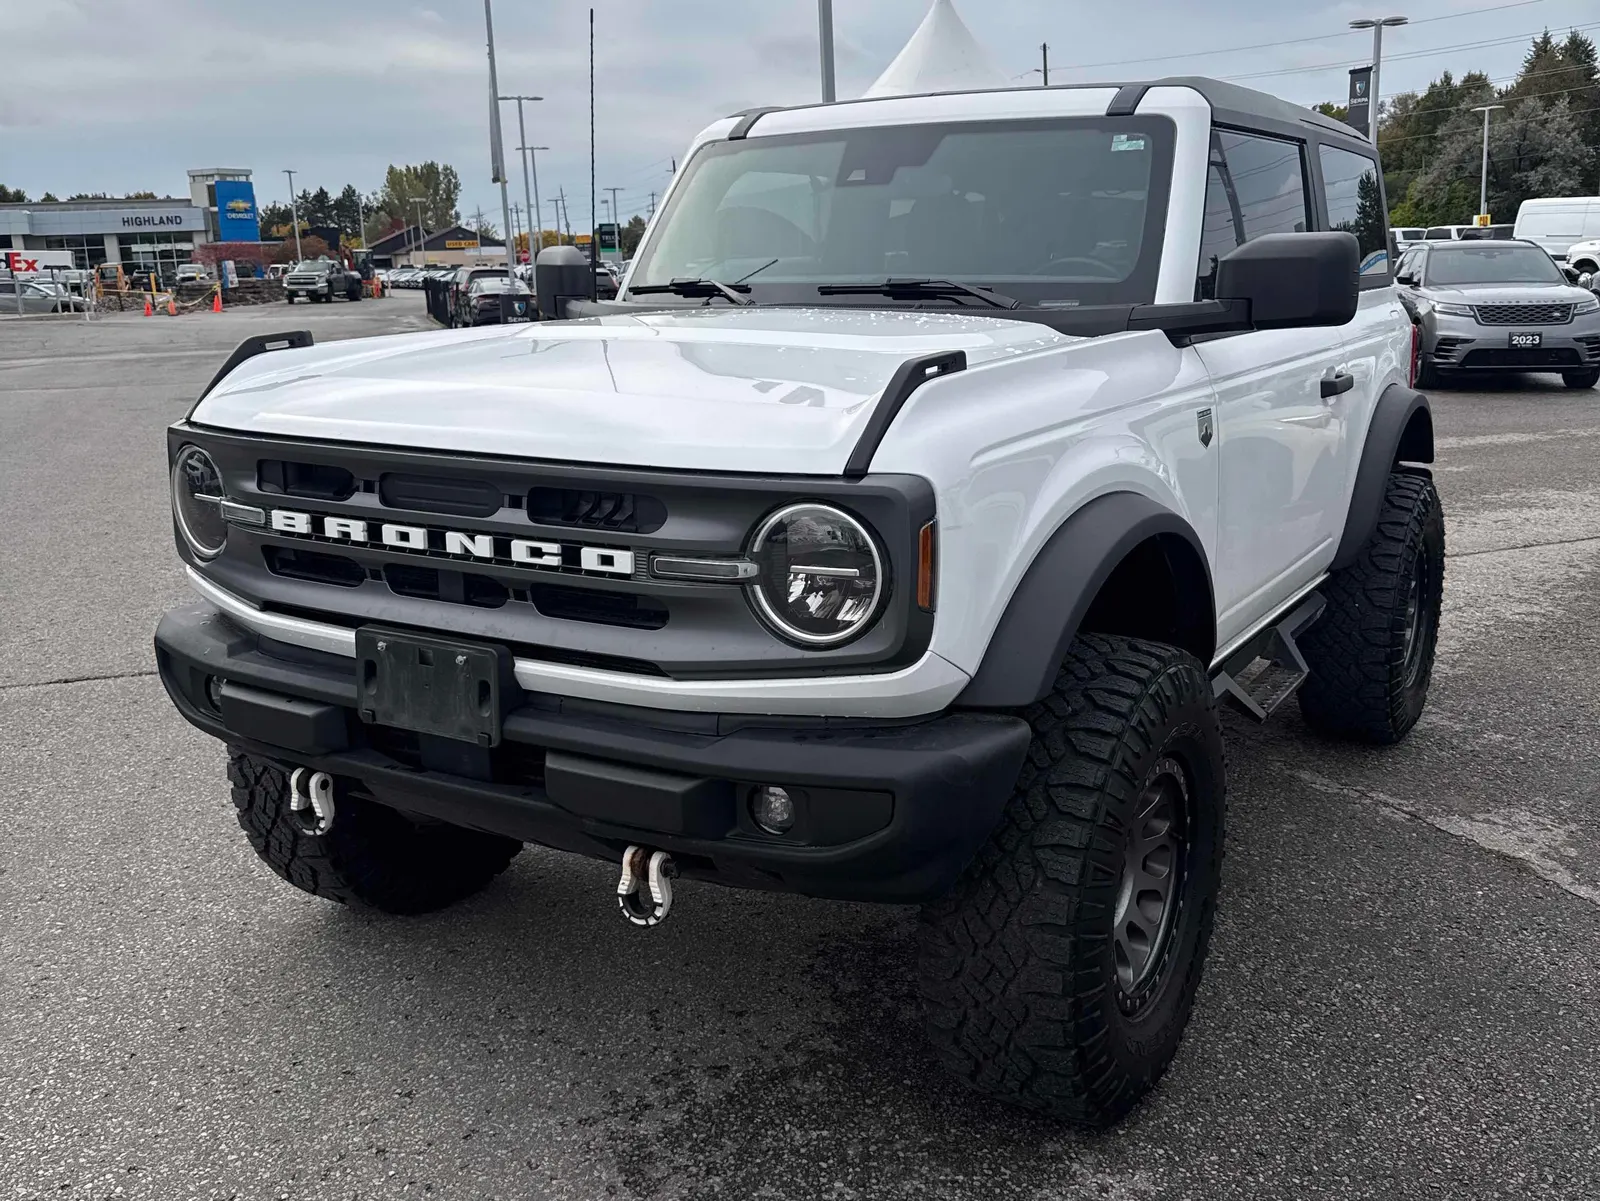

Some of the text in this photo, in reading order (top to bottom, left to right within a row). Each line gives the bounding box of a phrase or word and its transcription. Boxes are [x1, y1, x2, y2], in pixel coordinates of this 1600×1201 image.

[1350, 97, 1369, 105] SERPA
[122, 214, 183, 227] HIGHLAND
[1511, 335, 1540, 345] 2023
[271, 509, 635, 575] BRONCO
